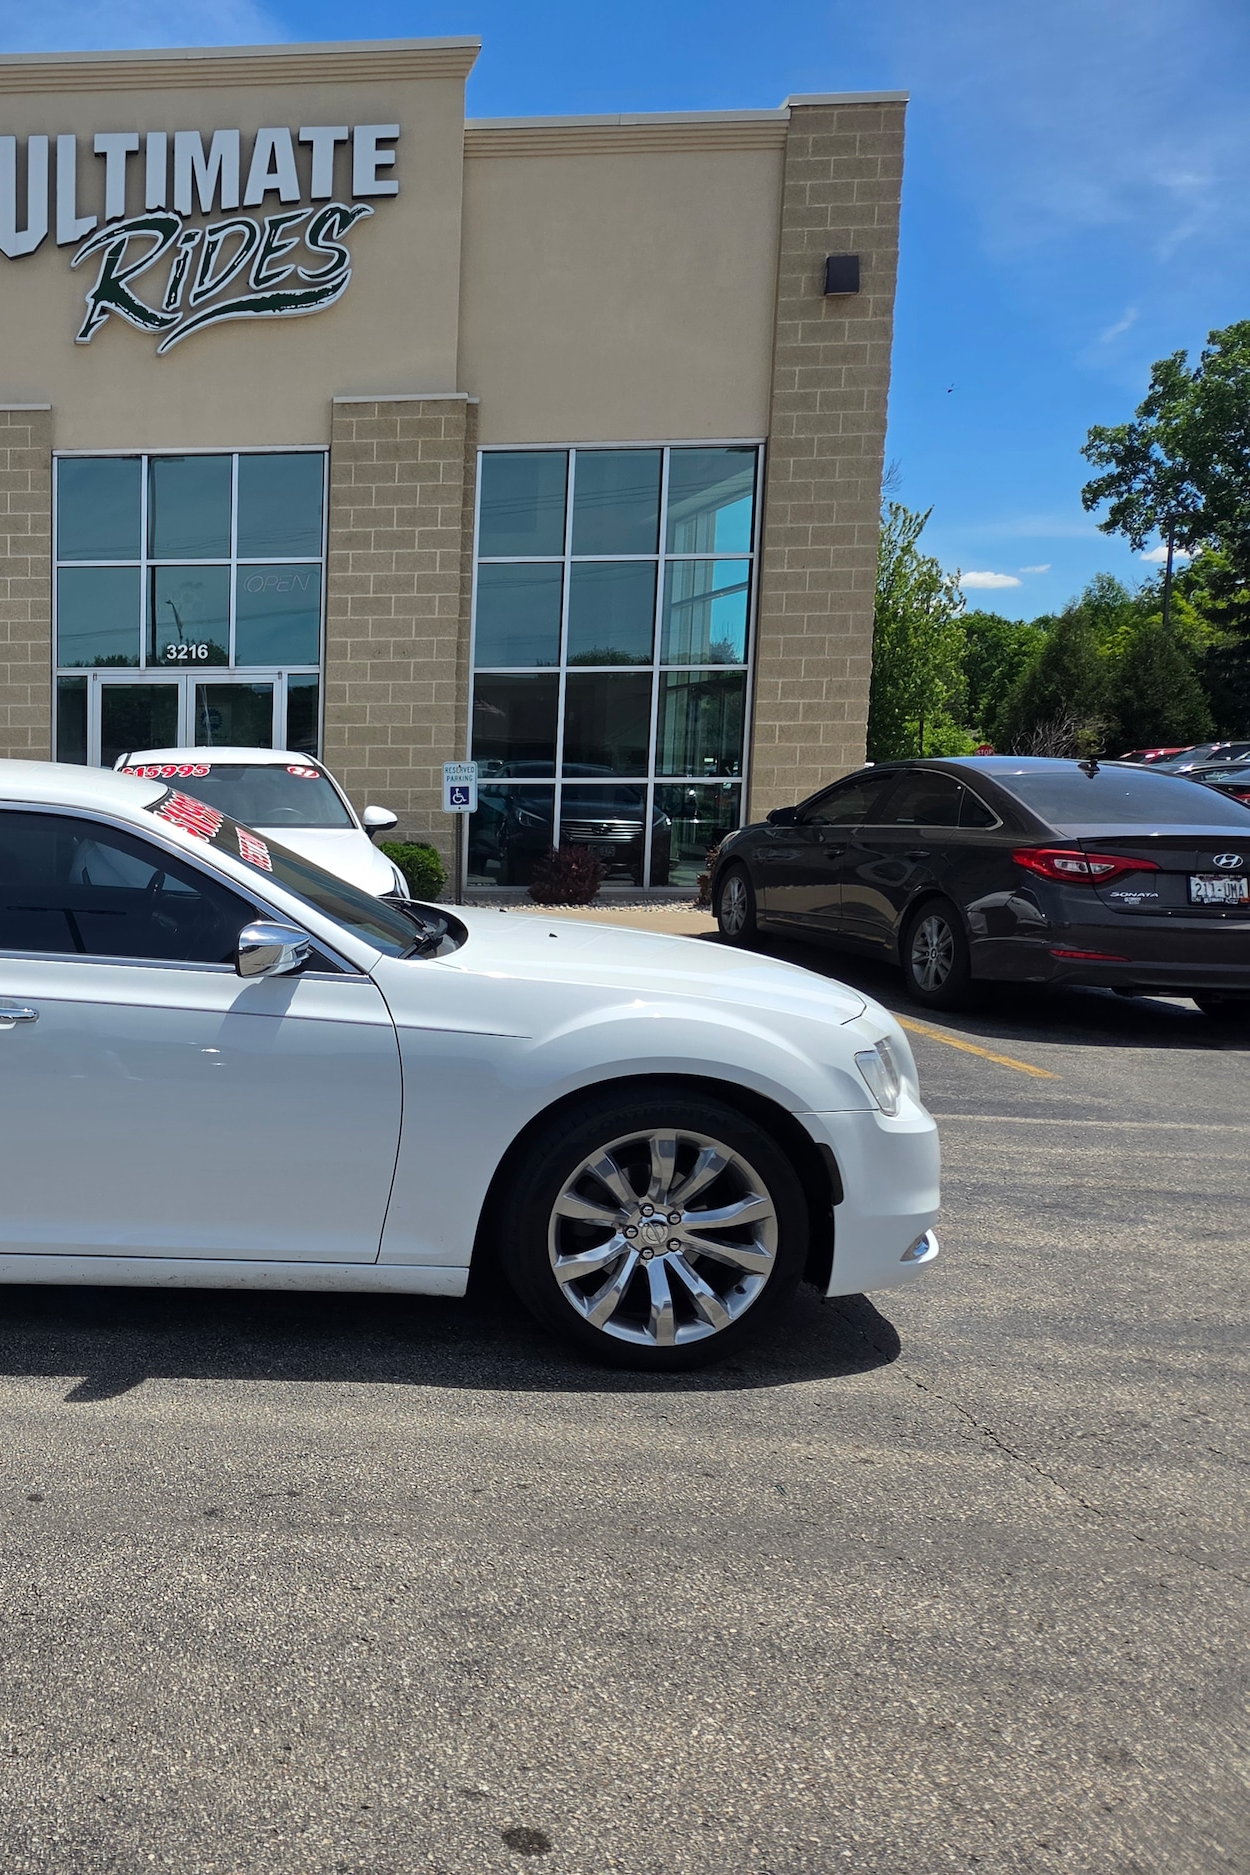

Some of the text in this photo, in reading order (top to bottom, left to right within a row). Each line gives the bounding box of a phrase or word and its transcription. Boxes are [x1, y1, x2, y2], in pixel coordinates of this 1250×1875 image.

[246, 574, 310, 593] OPEN
[166, 643, 209, 660] 3216
[445, 766, 475, 774] RESERVED
